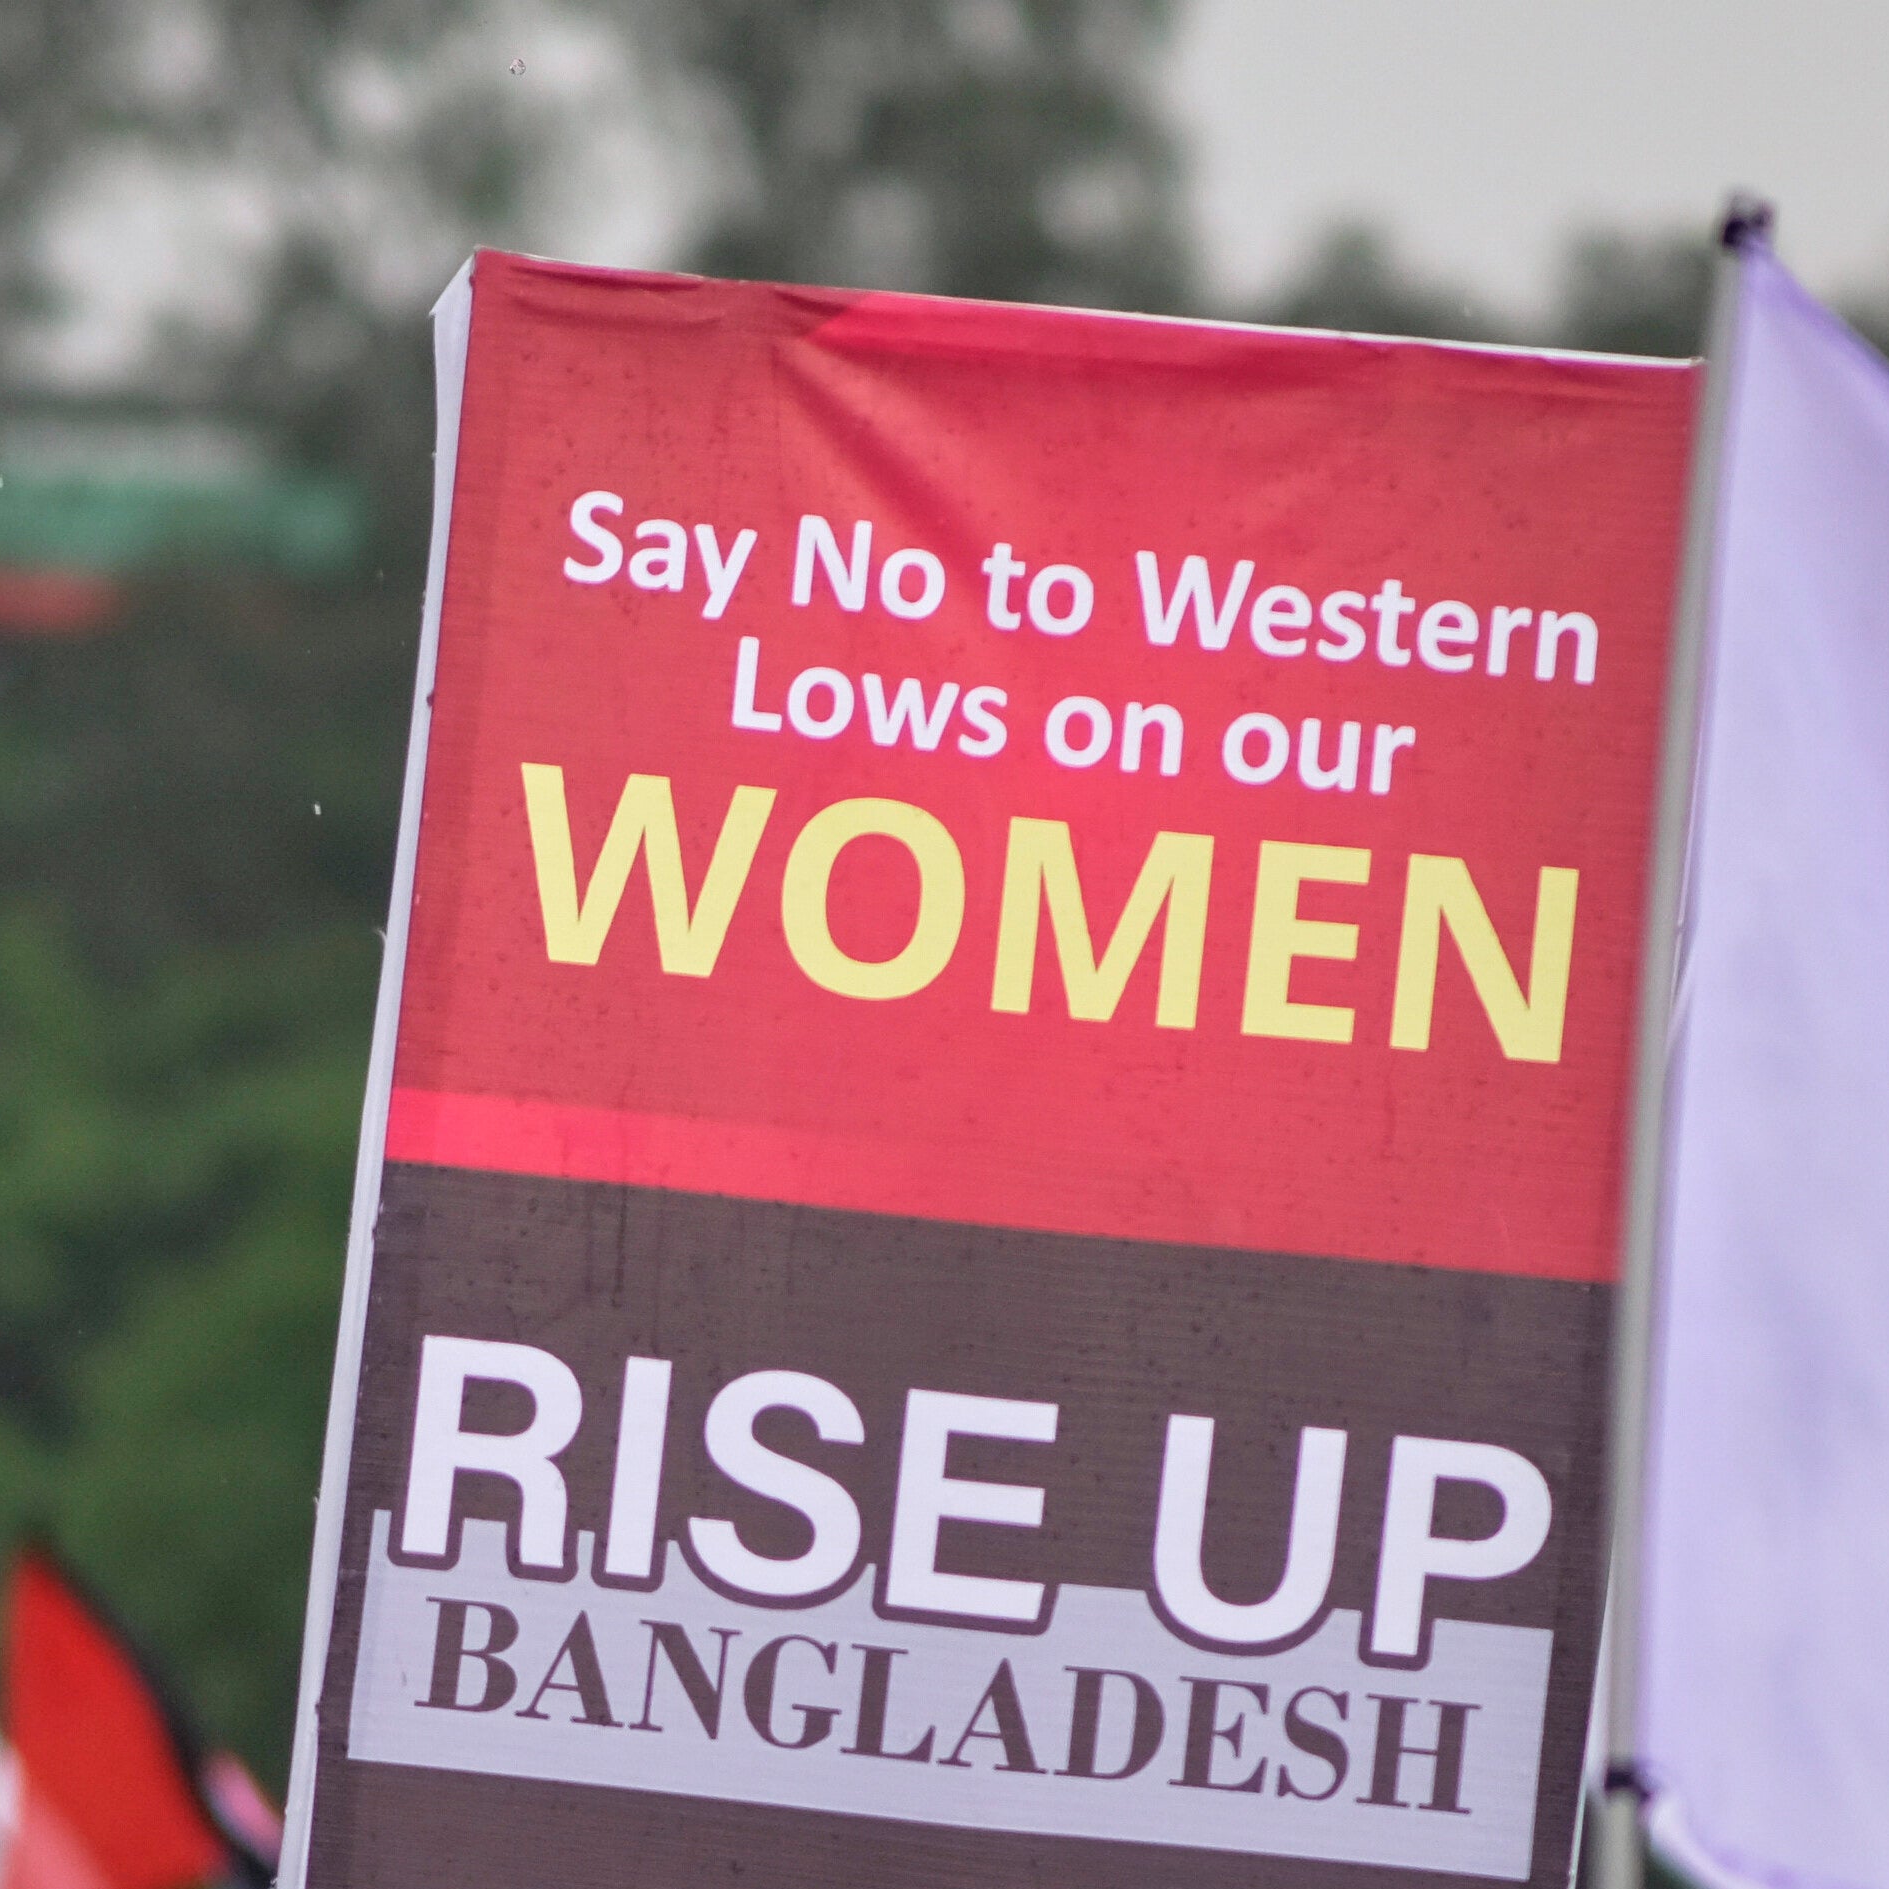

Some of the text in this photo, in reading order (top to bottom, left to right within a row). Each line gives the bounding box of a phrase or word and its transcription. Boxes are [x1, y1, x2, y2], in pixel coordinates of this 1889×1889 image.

[561, 490, 1601, 685] Say No to Western
[730, 637, 1415, 793] Lows on our
[520, 762, 1579, 1065] WOMEN
[398, 1335, 1552, 1658] RISE UP
[415, 1596, 1481, 1815] BANGLADESH
